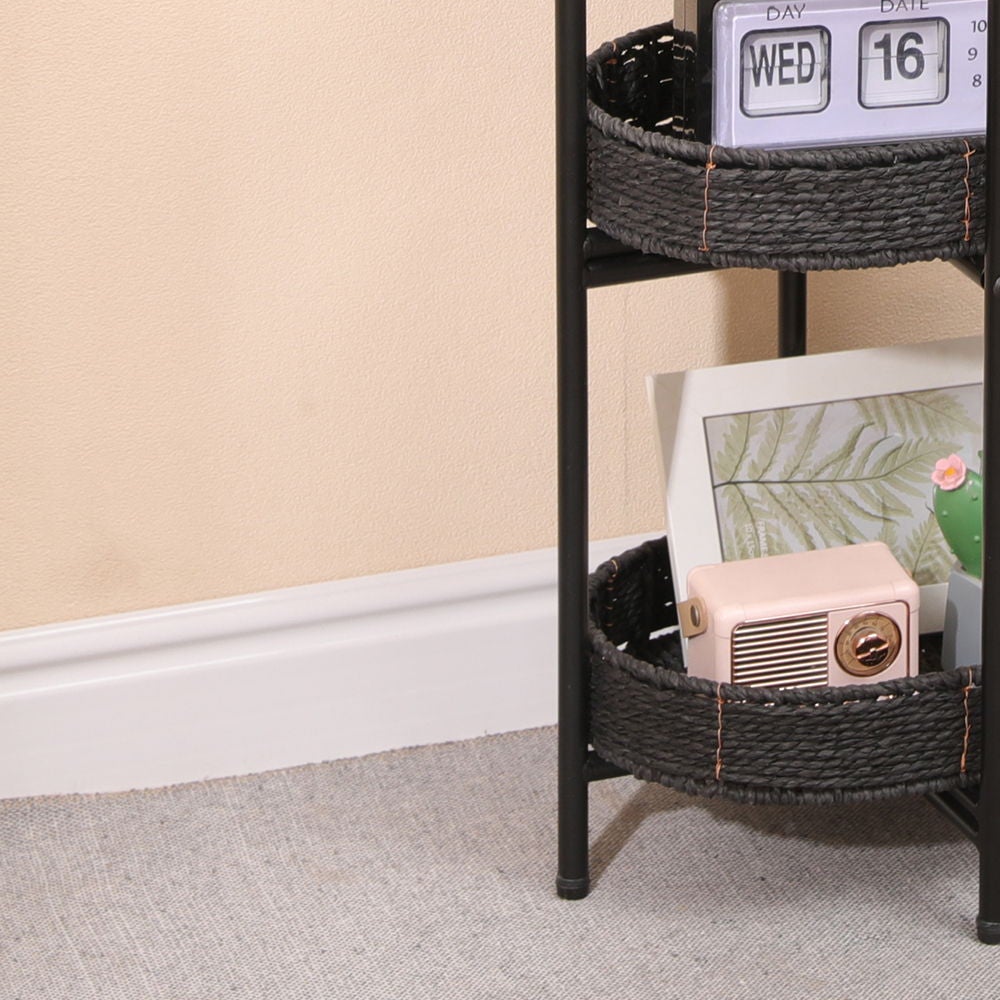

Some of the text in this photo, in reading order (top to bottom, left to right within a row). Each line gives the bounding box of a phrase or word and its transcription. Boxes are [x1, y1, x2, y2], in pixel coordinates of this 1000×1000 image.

[766, 3, 806, 21] DAY
[970, 19, 987, 33] 10
[874, 31, 925, 81] 16
[967, 47, 978, 61] 9
[749, 41, 816, 87] WED
[971, 73, 982, 88] 8
